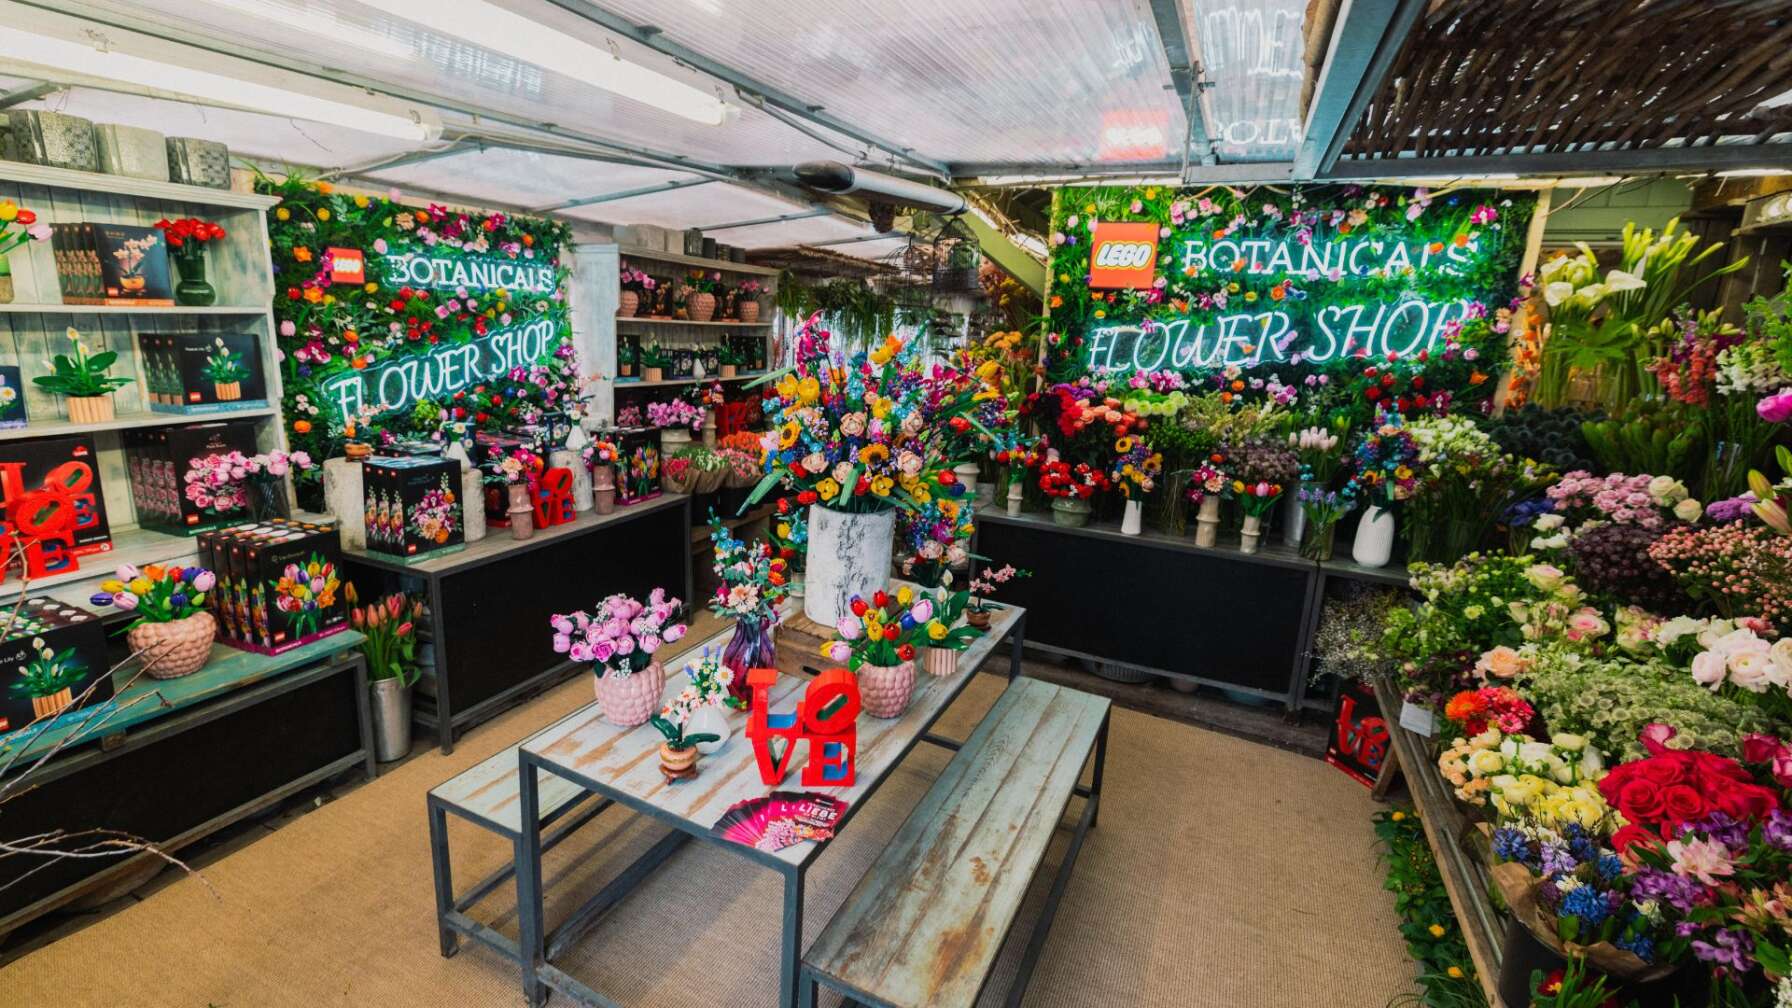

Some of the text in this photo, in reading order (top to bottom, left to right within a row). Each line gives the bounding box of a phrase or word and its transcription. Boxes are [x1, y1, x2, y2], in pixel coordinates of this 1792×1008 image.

[1096, 242, 1153, 268] LEGO
[491, 319, 554, 374] SHOP
[1088, 311, 1290, 372] FLOWER
